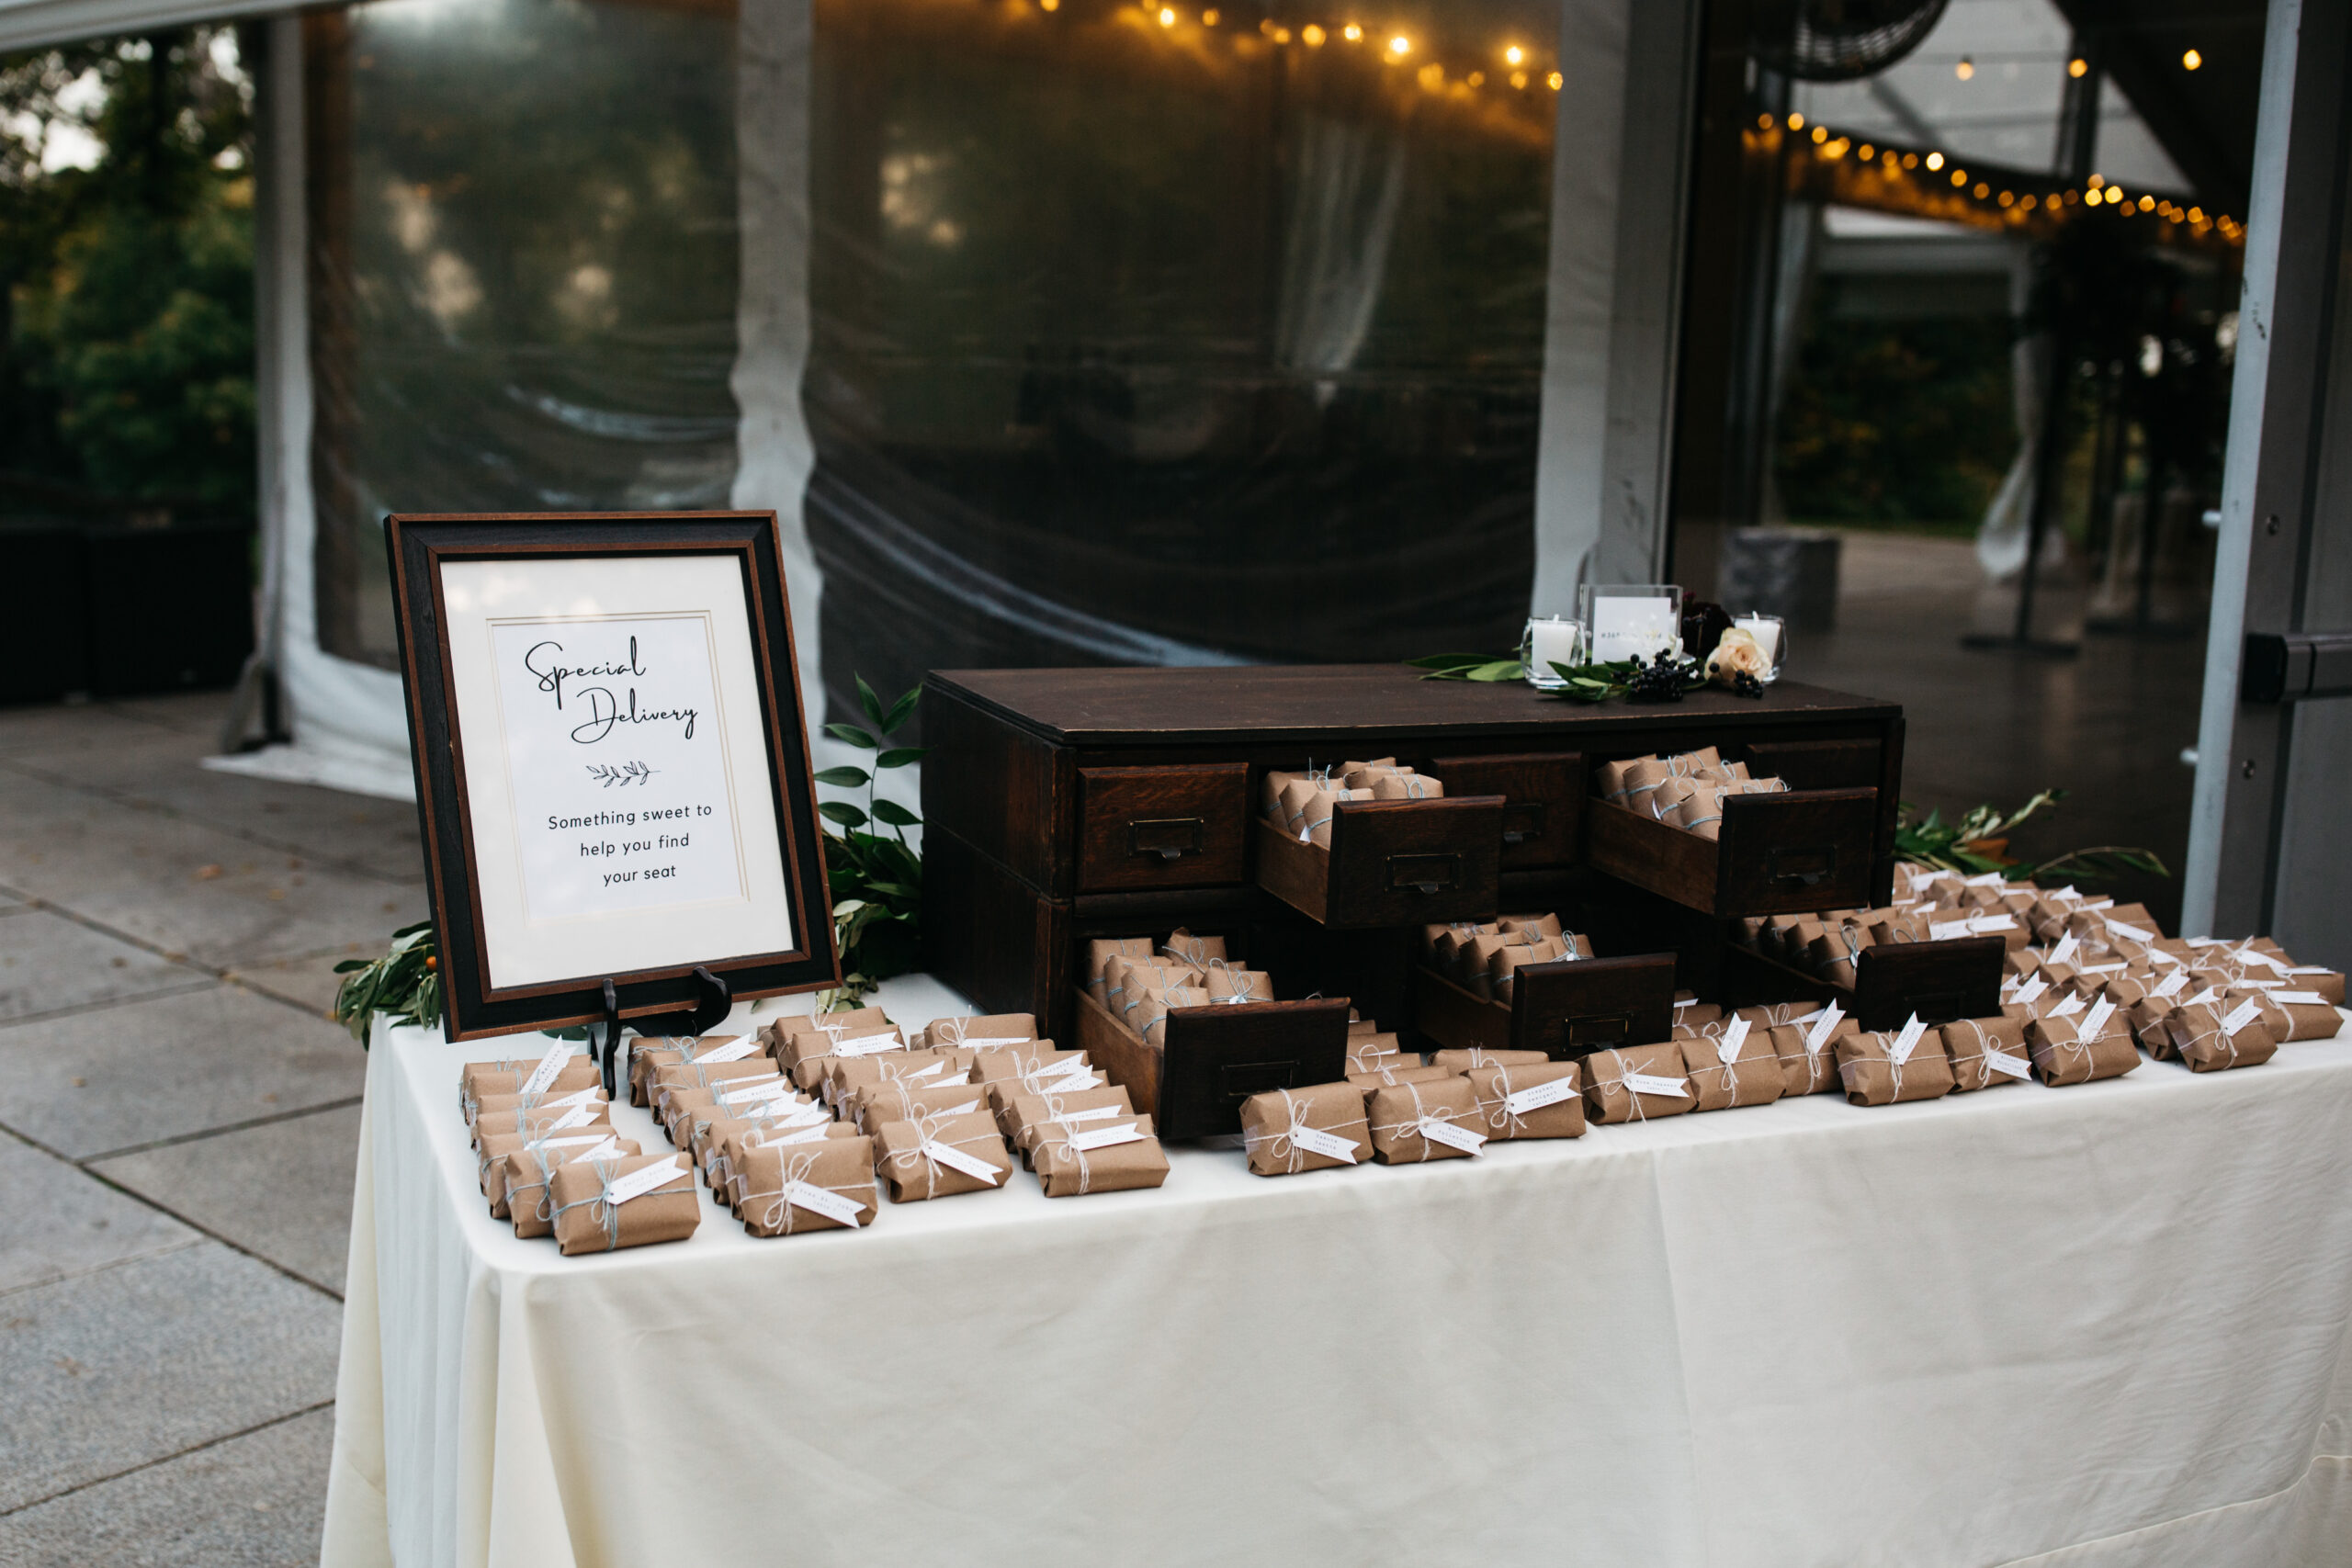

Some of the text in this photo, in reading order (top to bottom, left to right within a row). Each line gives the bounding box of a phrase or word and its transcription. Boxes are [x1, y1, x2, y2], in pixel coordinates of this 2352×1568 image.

[525, 635, 647, 712] Special
[571, 687, 698, 744] Delivery
[548, 805, 712, 830] Something sweet to
[581, 832, 689, 858] help you find
[603, 865, 676, 887] your seat
